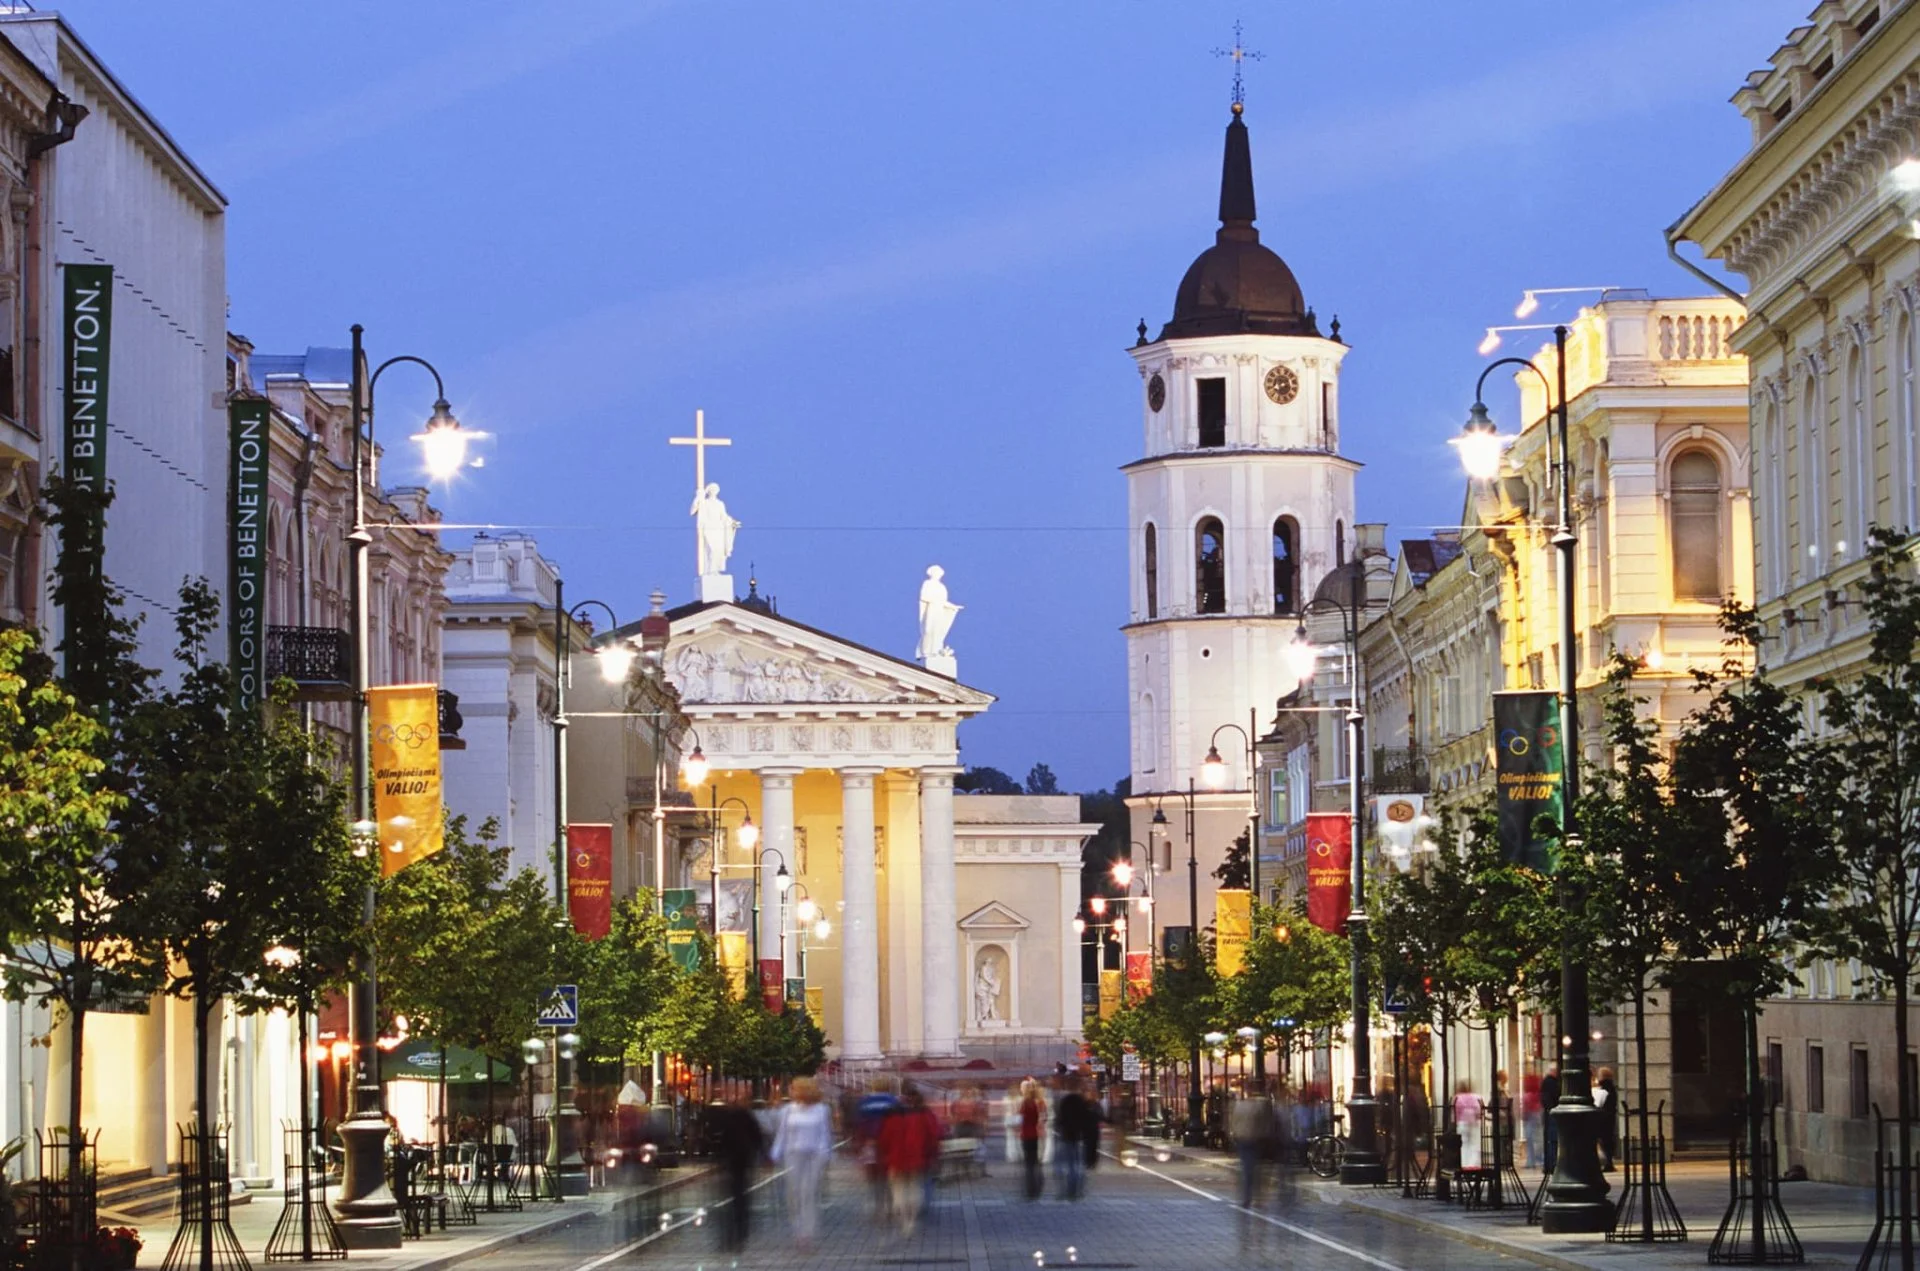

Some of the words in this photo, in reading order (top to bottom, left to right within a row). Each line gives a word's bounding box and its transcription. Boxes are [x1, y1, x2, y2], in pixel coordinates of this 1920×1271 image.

[73, 281, 101, 458] BENETTON.
[238, 412, 260, 558] BENETTON.
[238, 565, 255, 600] OF
[386, 781, 429, 795] VALIO!
[1509, 785, 1553, 800] VALIO!
